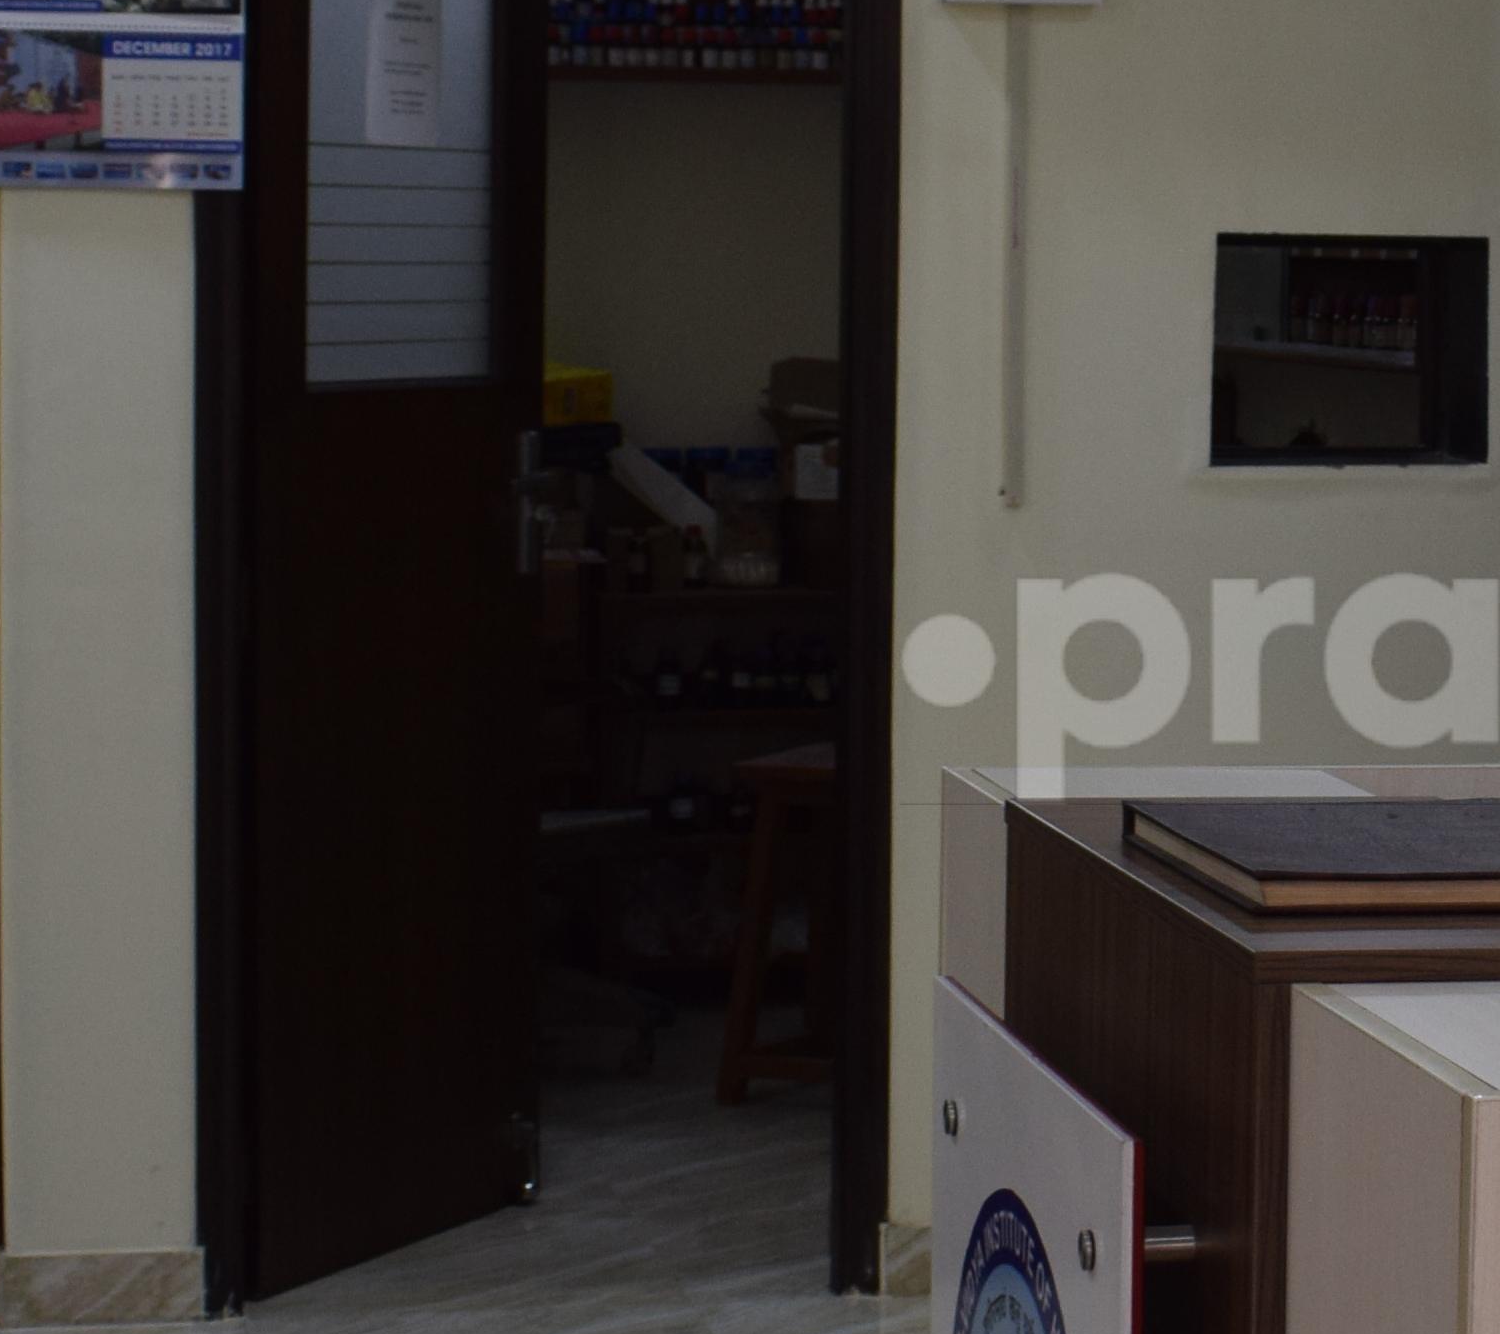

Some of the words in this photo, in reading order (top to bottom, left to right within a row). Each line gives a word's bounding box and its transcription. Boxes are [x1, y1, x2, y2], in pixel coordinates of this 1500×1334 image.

[112, 39, 192, 57] DECEMBER
[195, 41, 233, 58] 2017
[983, 1210, 1036, 1279] INSTITUTE
[1035, 1261, 1053, 1315] OF
